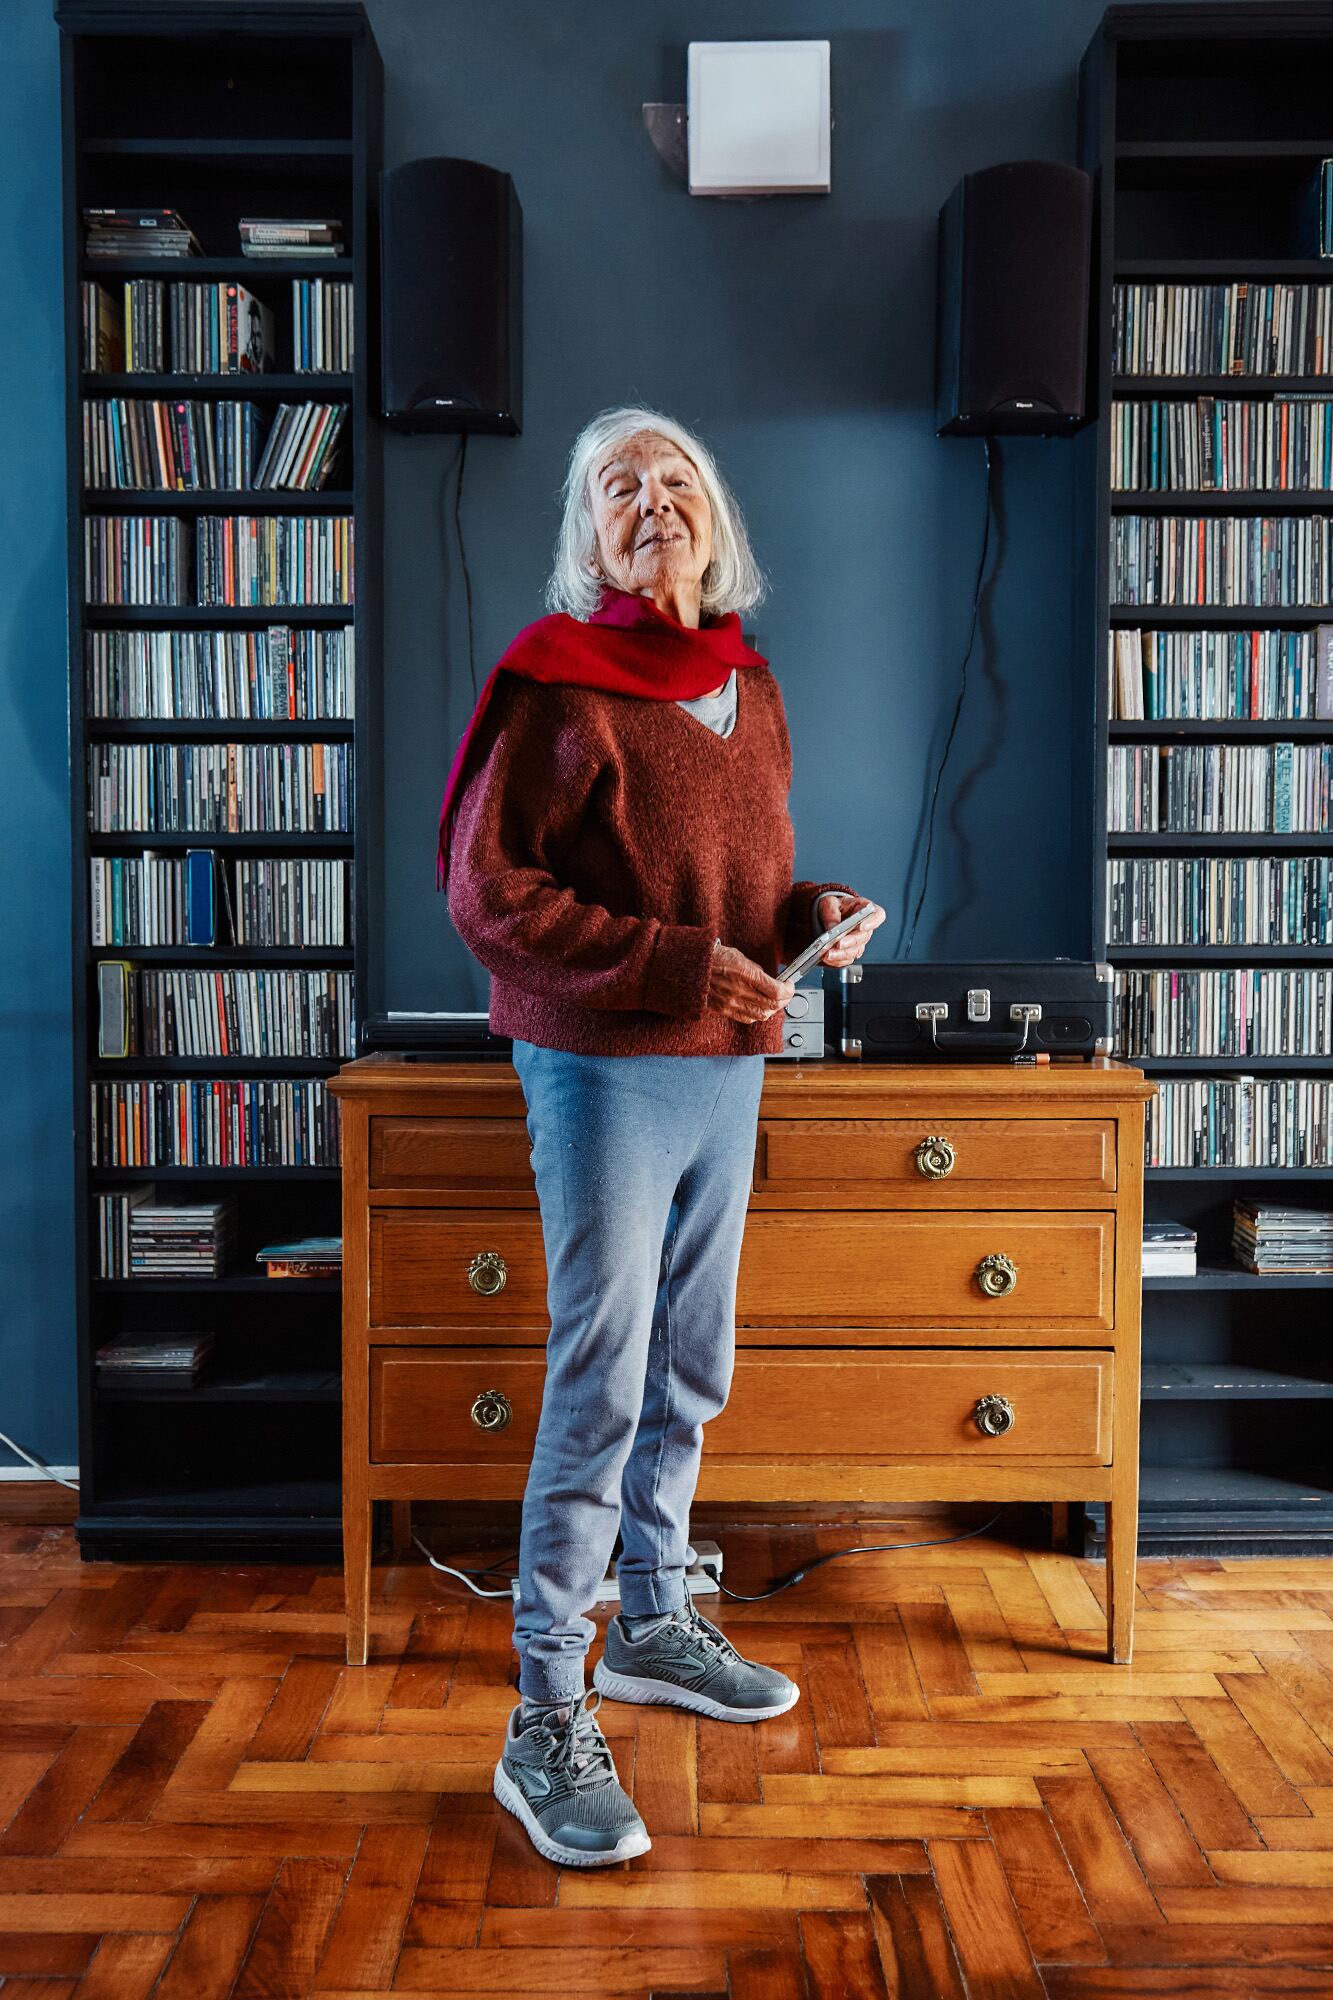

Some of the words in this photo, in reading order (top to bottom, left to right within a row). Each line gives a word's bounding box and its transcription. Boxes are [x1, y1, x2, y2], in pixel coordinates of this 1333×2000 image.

[278, 644, 286, 680] CLIFFORD
[278, 682, 288, 714] BROWN
[1282, 760, 1290, 778] LEE
[1281, 784, 1290, 831] MORGAN
